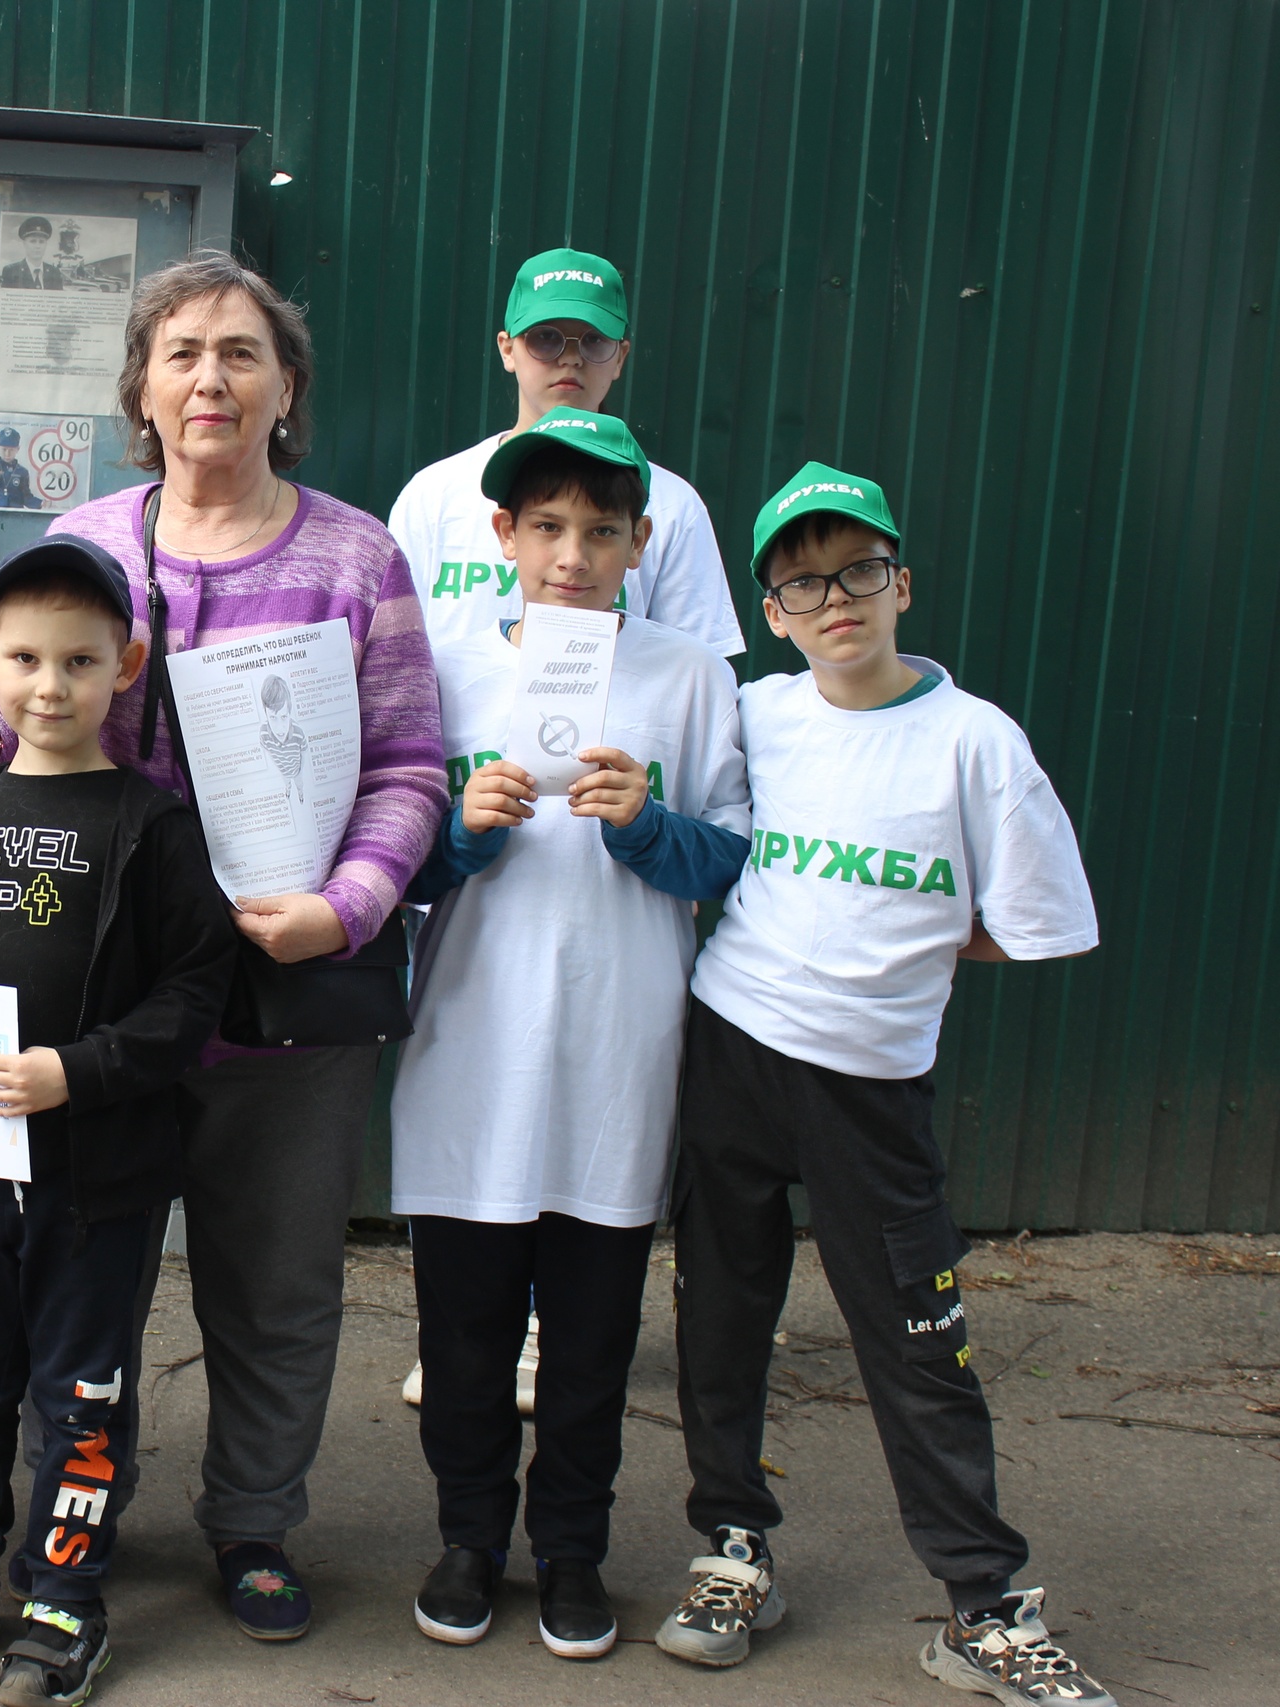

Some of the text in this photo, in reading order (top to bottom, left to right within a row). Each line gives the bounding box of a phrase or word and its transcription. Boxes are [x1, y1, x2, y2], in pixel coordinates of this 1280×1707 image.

[533, 270, 604, 291] ДРУЖБА
[65, 421, 90, 441] 90
[531, 419, 598, 432] УЖБА
[38, 443, 63, 462] 60
[44, 471, 70, 491] 20
[776, 483, 864, 515] ДРУЖБА
[202, 630, 323, 664] КАК ОПРЕДЕЛИТЬ, ЧТО ВАШ РЕБЁНОК
[565, 640, 600, 654] Если
[226, 650, 308, 675] ПРИНИМАЕТ НАРКОТИКИ
[542, 661, 592, 675] курите
[527, 679, 599, 695] бросайте!
[750, 828, 957, 897] ДРУЖБА
[907, 1319, 932, 1333] Let
[935, 1315, 951, 1331] me
[45, 1366, 121, 1567] TMES
